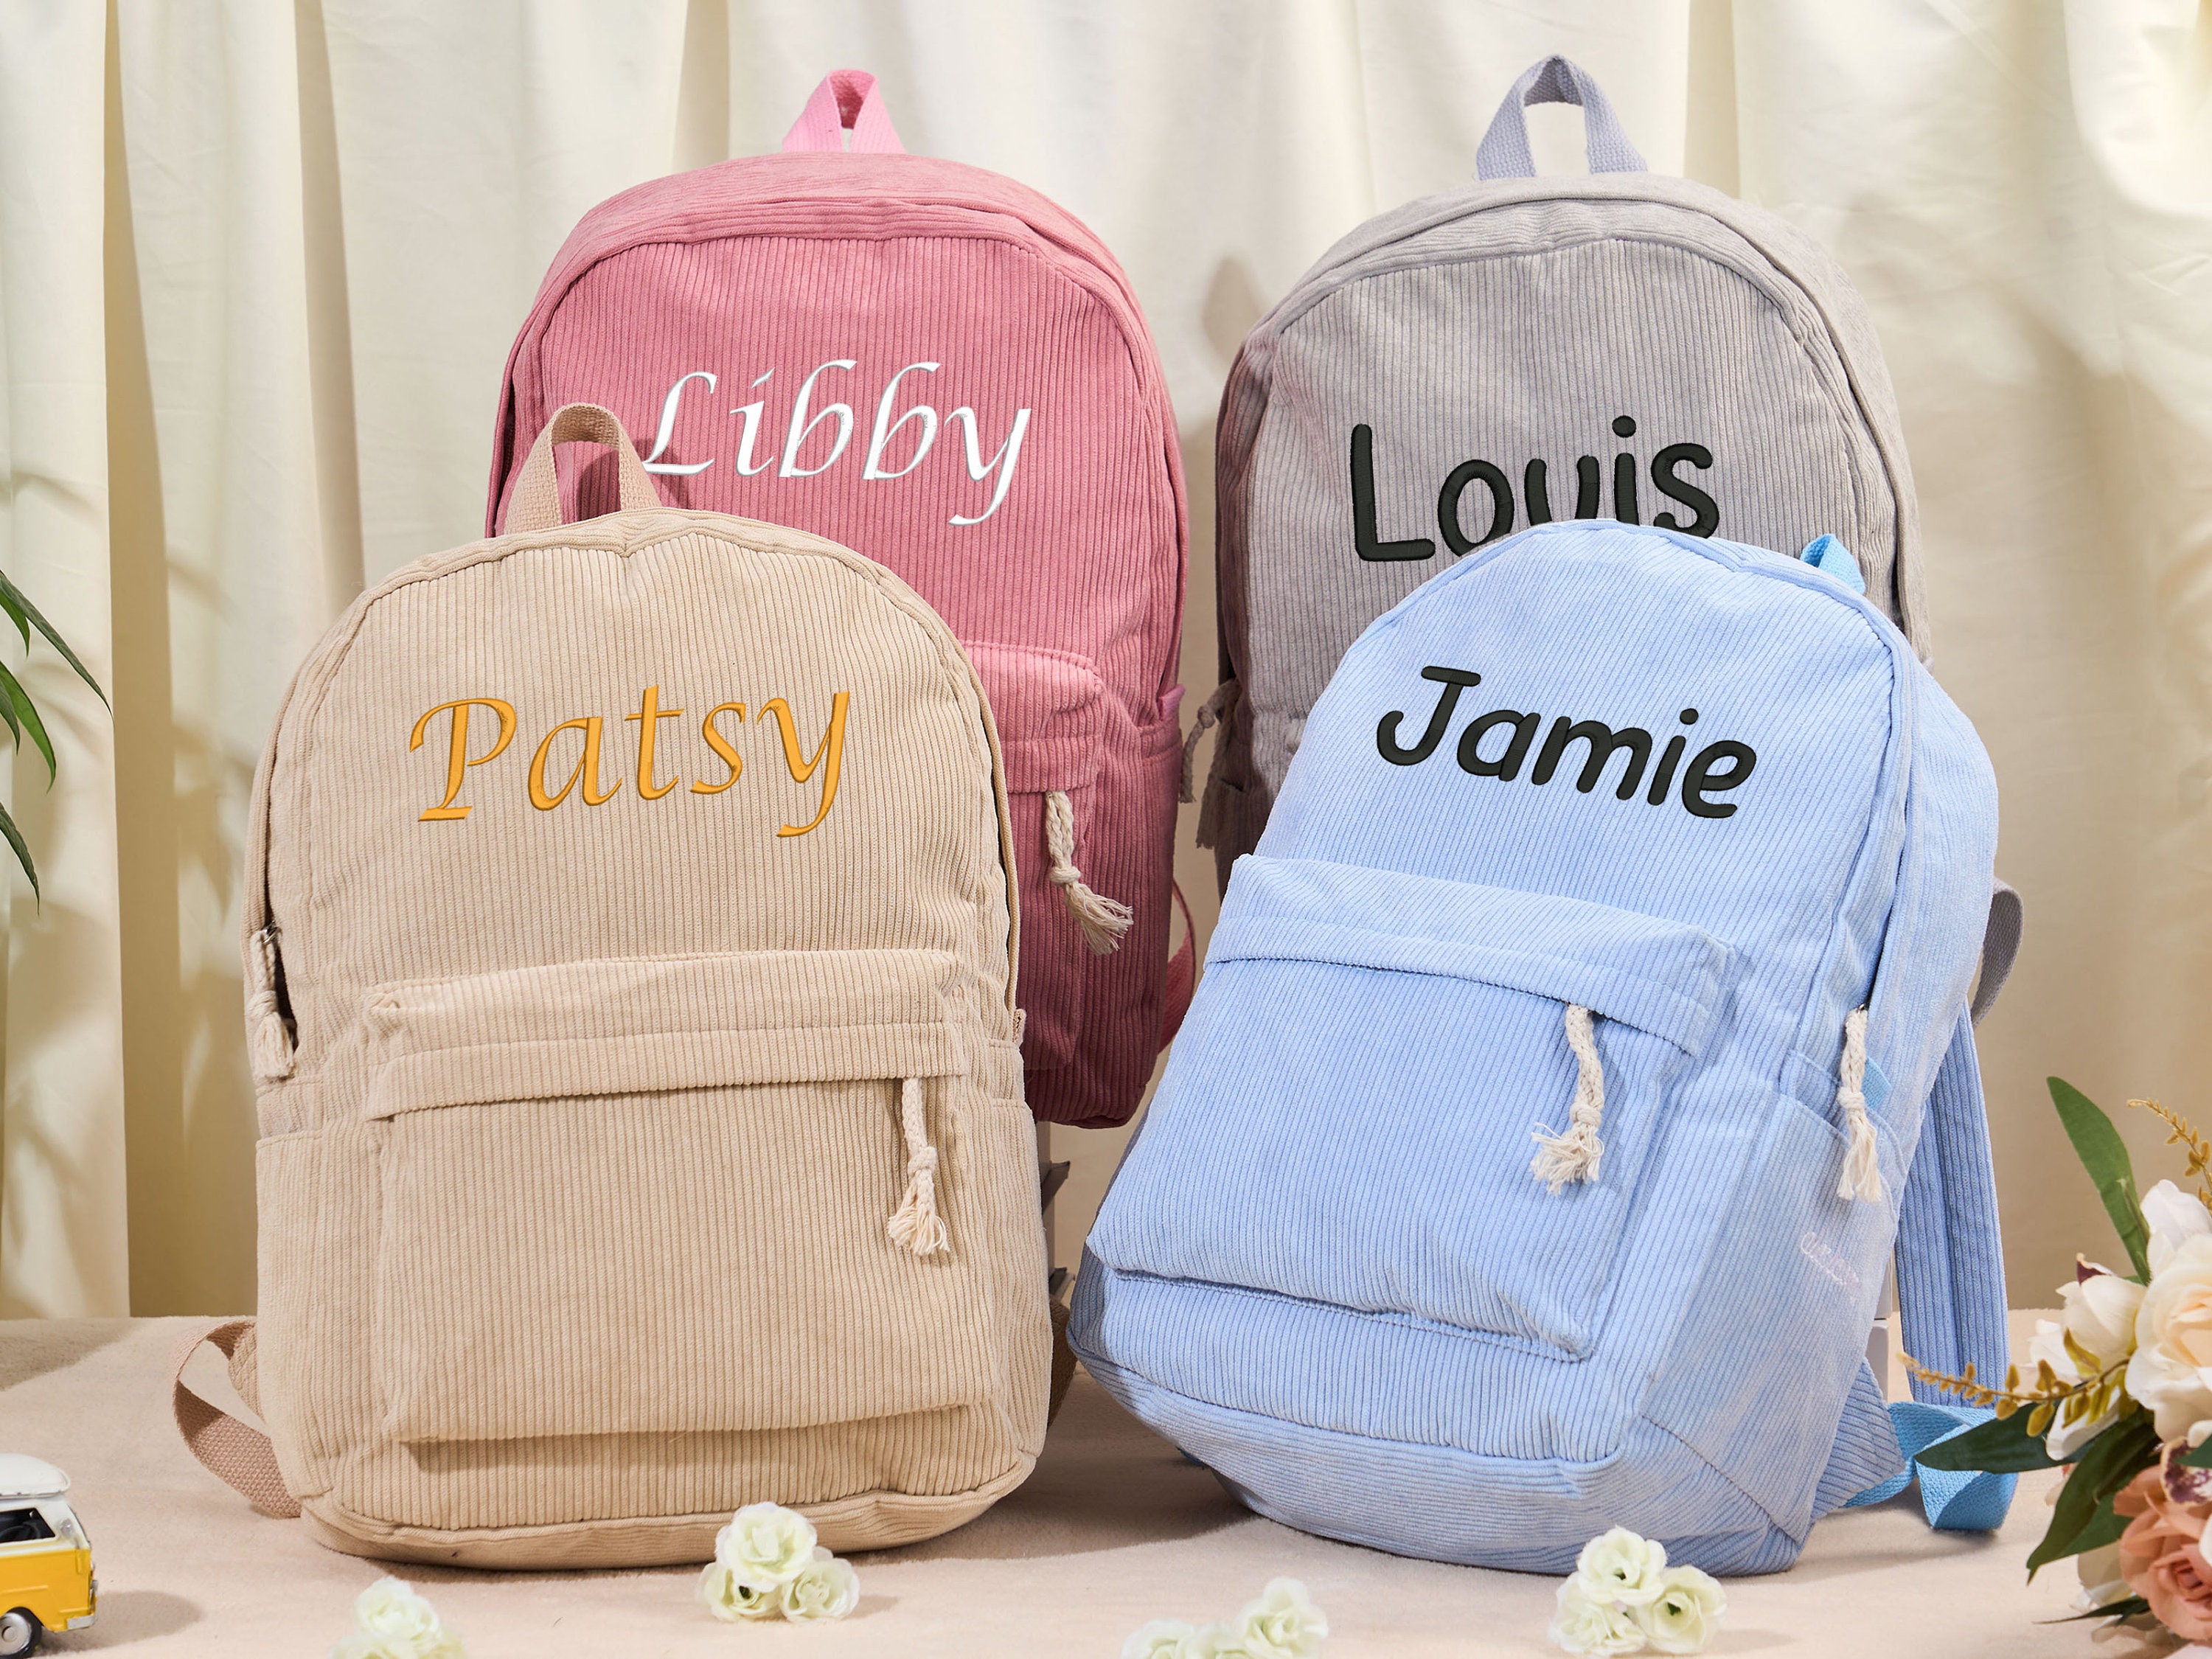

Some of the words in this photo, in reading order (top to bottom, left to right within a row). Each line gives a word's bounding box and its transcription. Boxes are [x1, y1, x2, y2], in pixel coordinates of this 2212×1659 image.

[641, 358, 1033, 527] Libby
[1349, 414, 1720, 563] Louis
[409, 684, 850, 838] Patsy
[1377, 665, 1758, 820] Jamie
